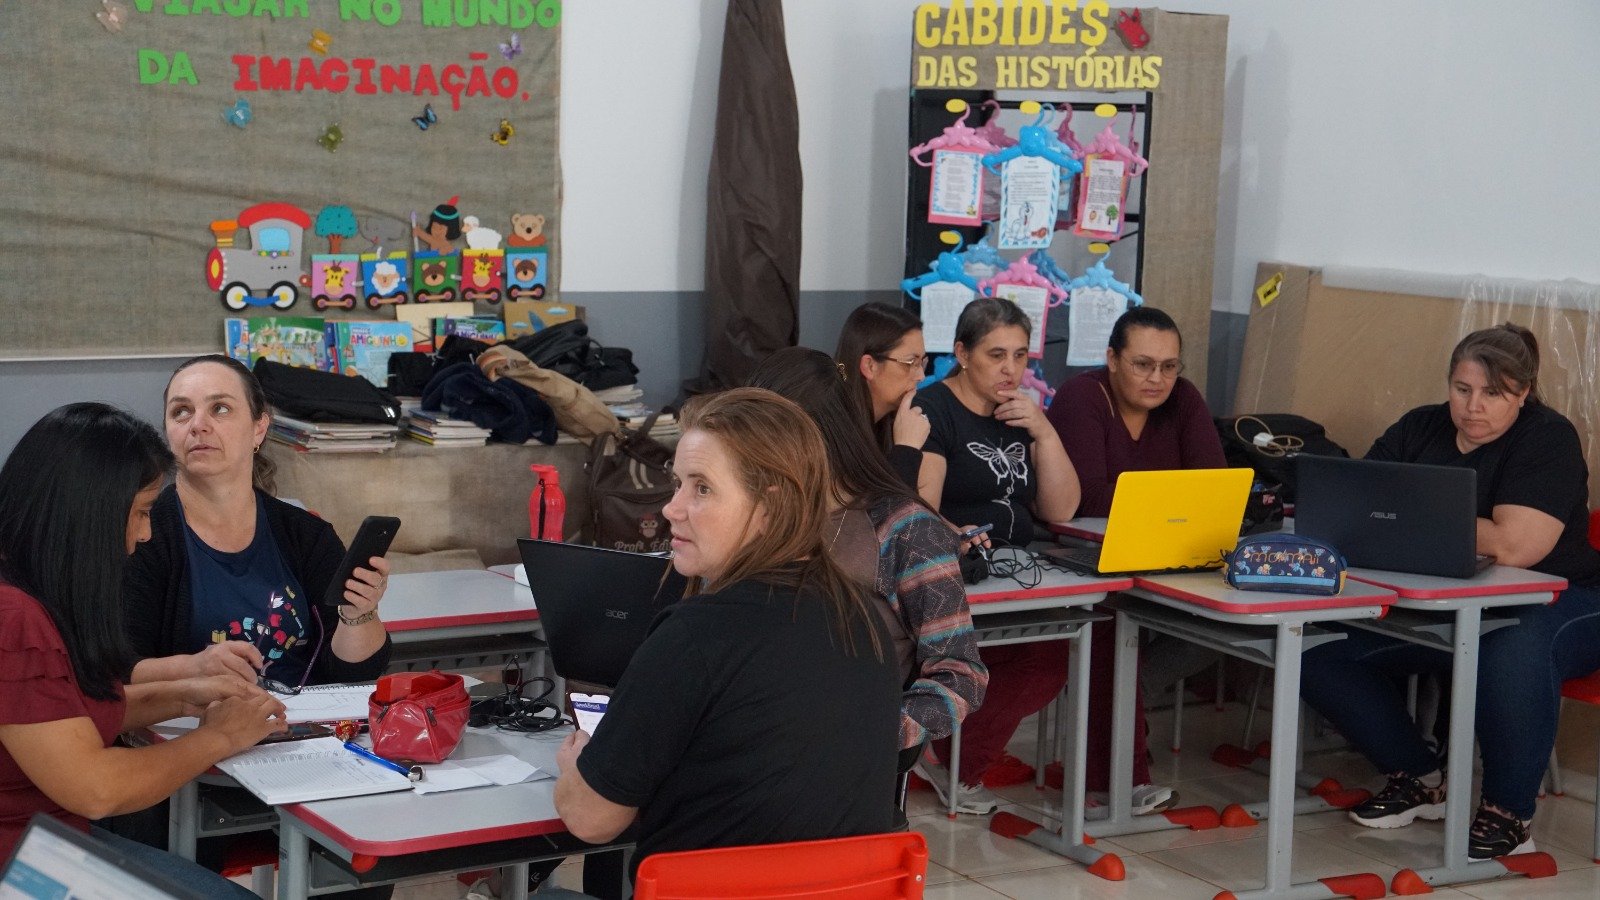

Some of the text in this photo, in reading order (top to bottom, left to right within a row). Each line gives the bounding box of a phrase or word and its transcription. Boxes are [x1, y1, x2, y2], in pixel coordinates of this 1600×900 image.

[338, 0, 402, 27] NO
[421, 0, 562, 30] MUNDO
[914, 0, 1111, 48] CABIDES
[137, 48, 531, 111] DA IMAGINAÇÃO.
[916, 46, 1163, 90] DAS HISTÓRIAS
[1370, 511, 1397, 520] ASUS
[605, 608, 629, 620] acer
